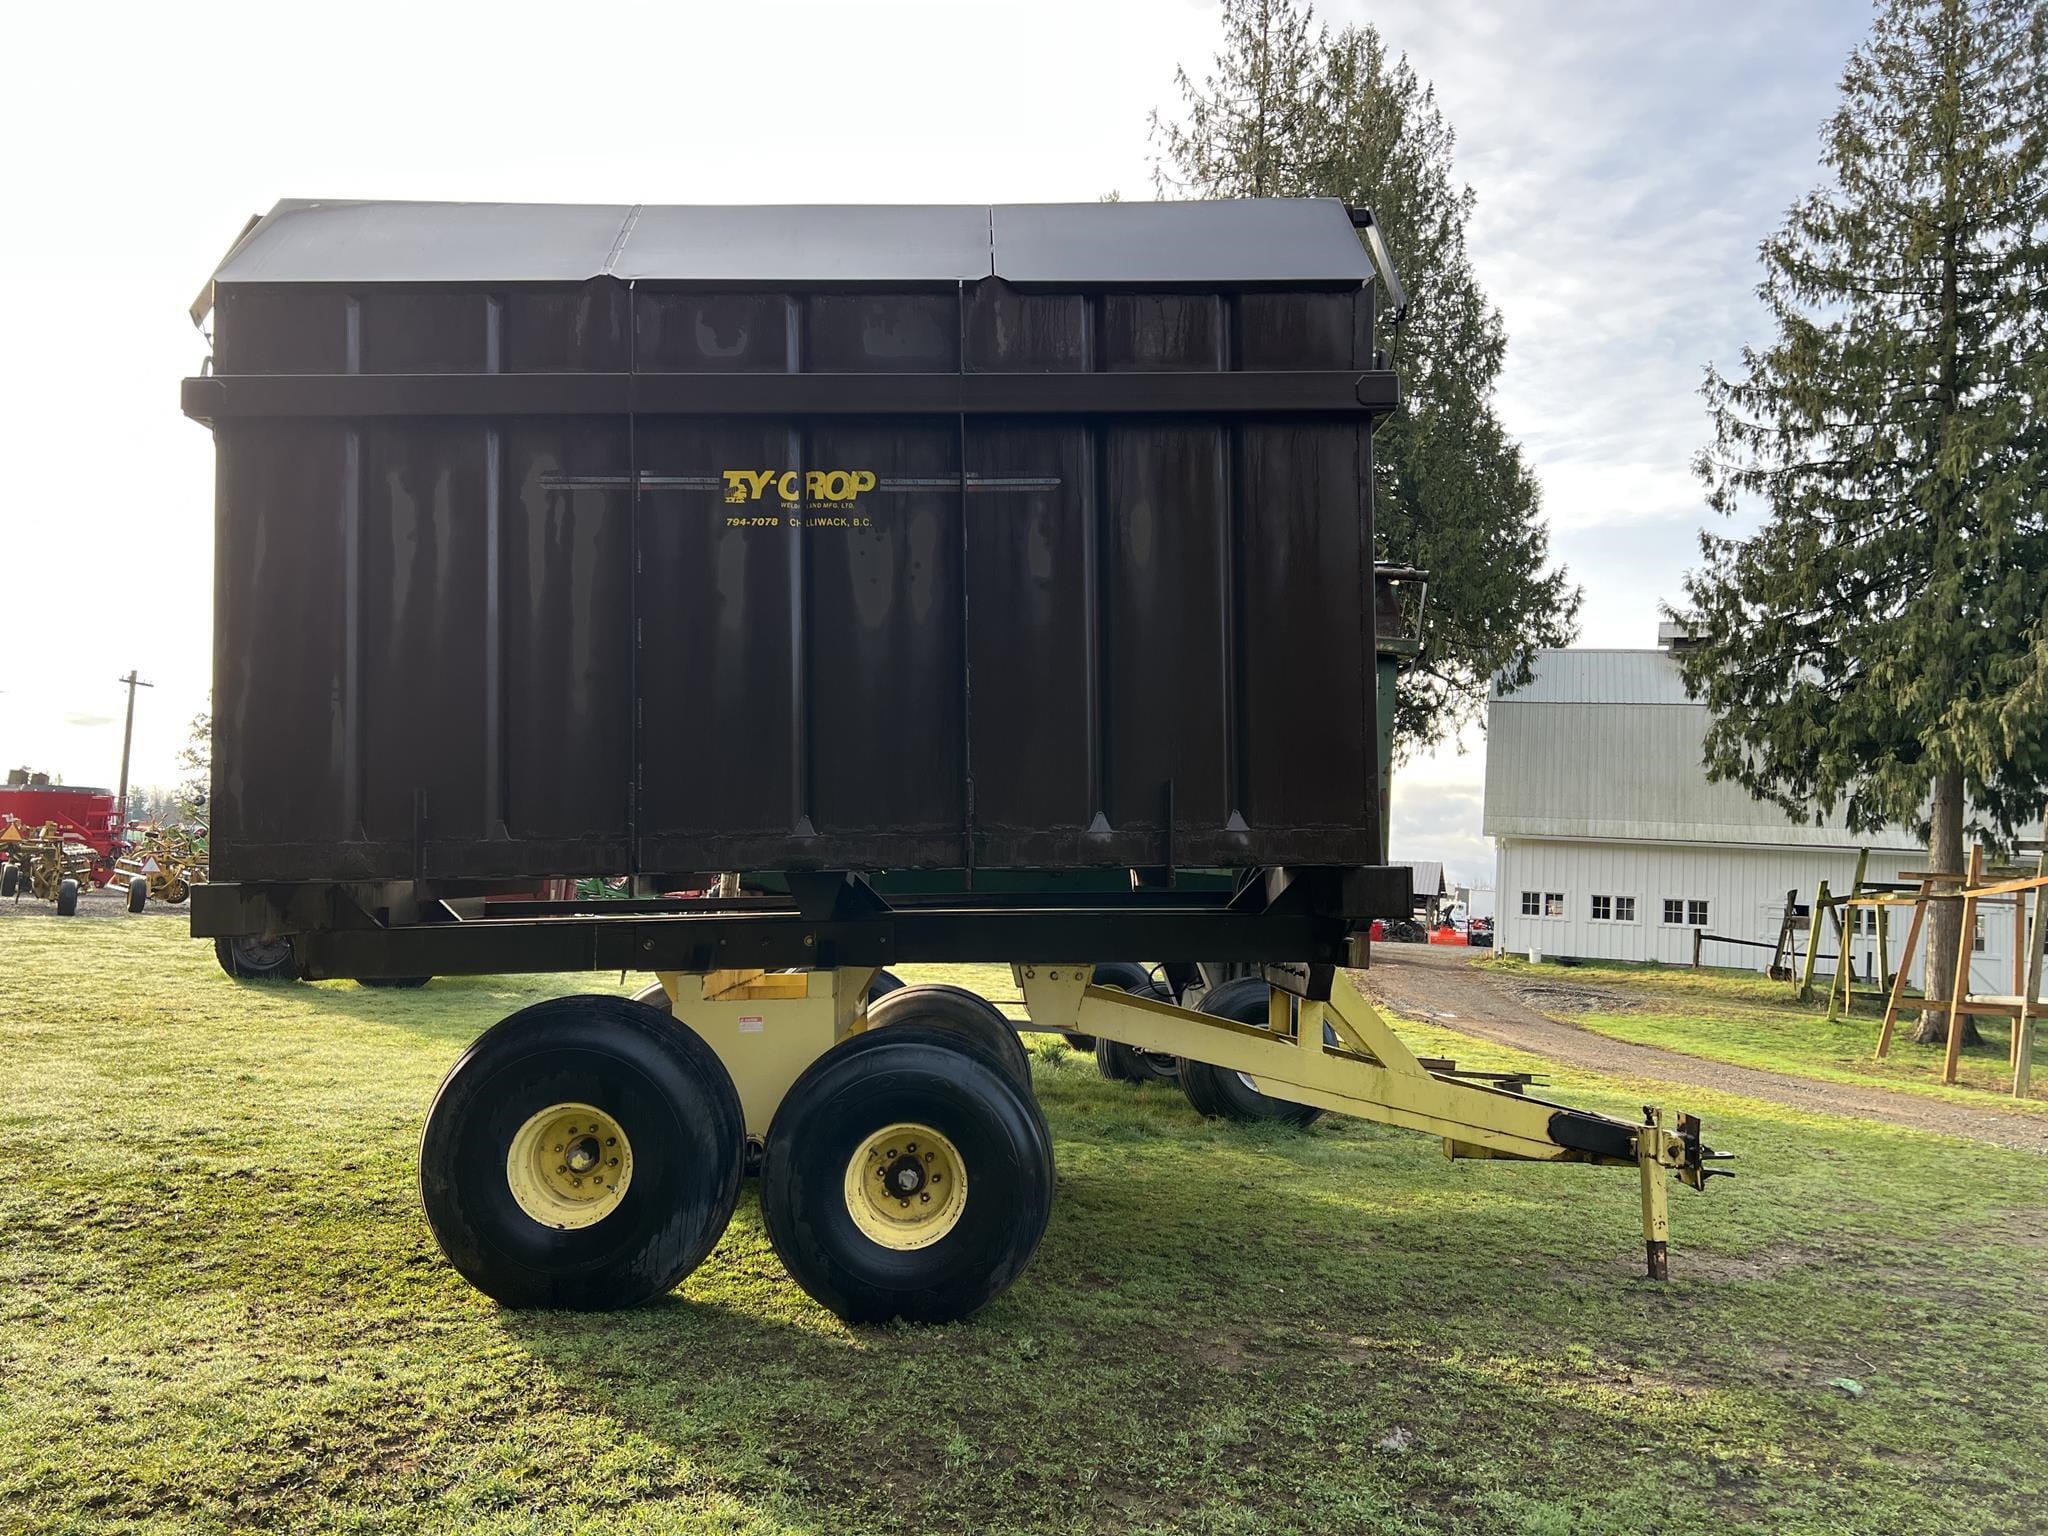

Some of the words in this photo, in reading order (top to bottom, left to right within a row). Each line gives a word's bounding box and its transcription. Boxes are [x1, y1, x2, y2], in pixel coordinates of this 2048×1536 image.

[723, 470, 876, 501] TY-CROP
[726, 518, 778, 526] 794-7078
[789, 518, 850, 527] CHLLIWACK,
[853, 518, 872, 527] B.C.
